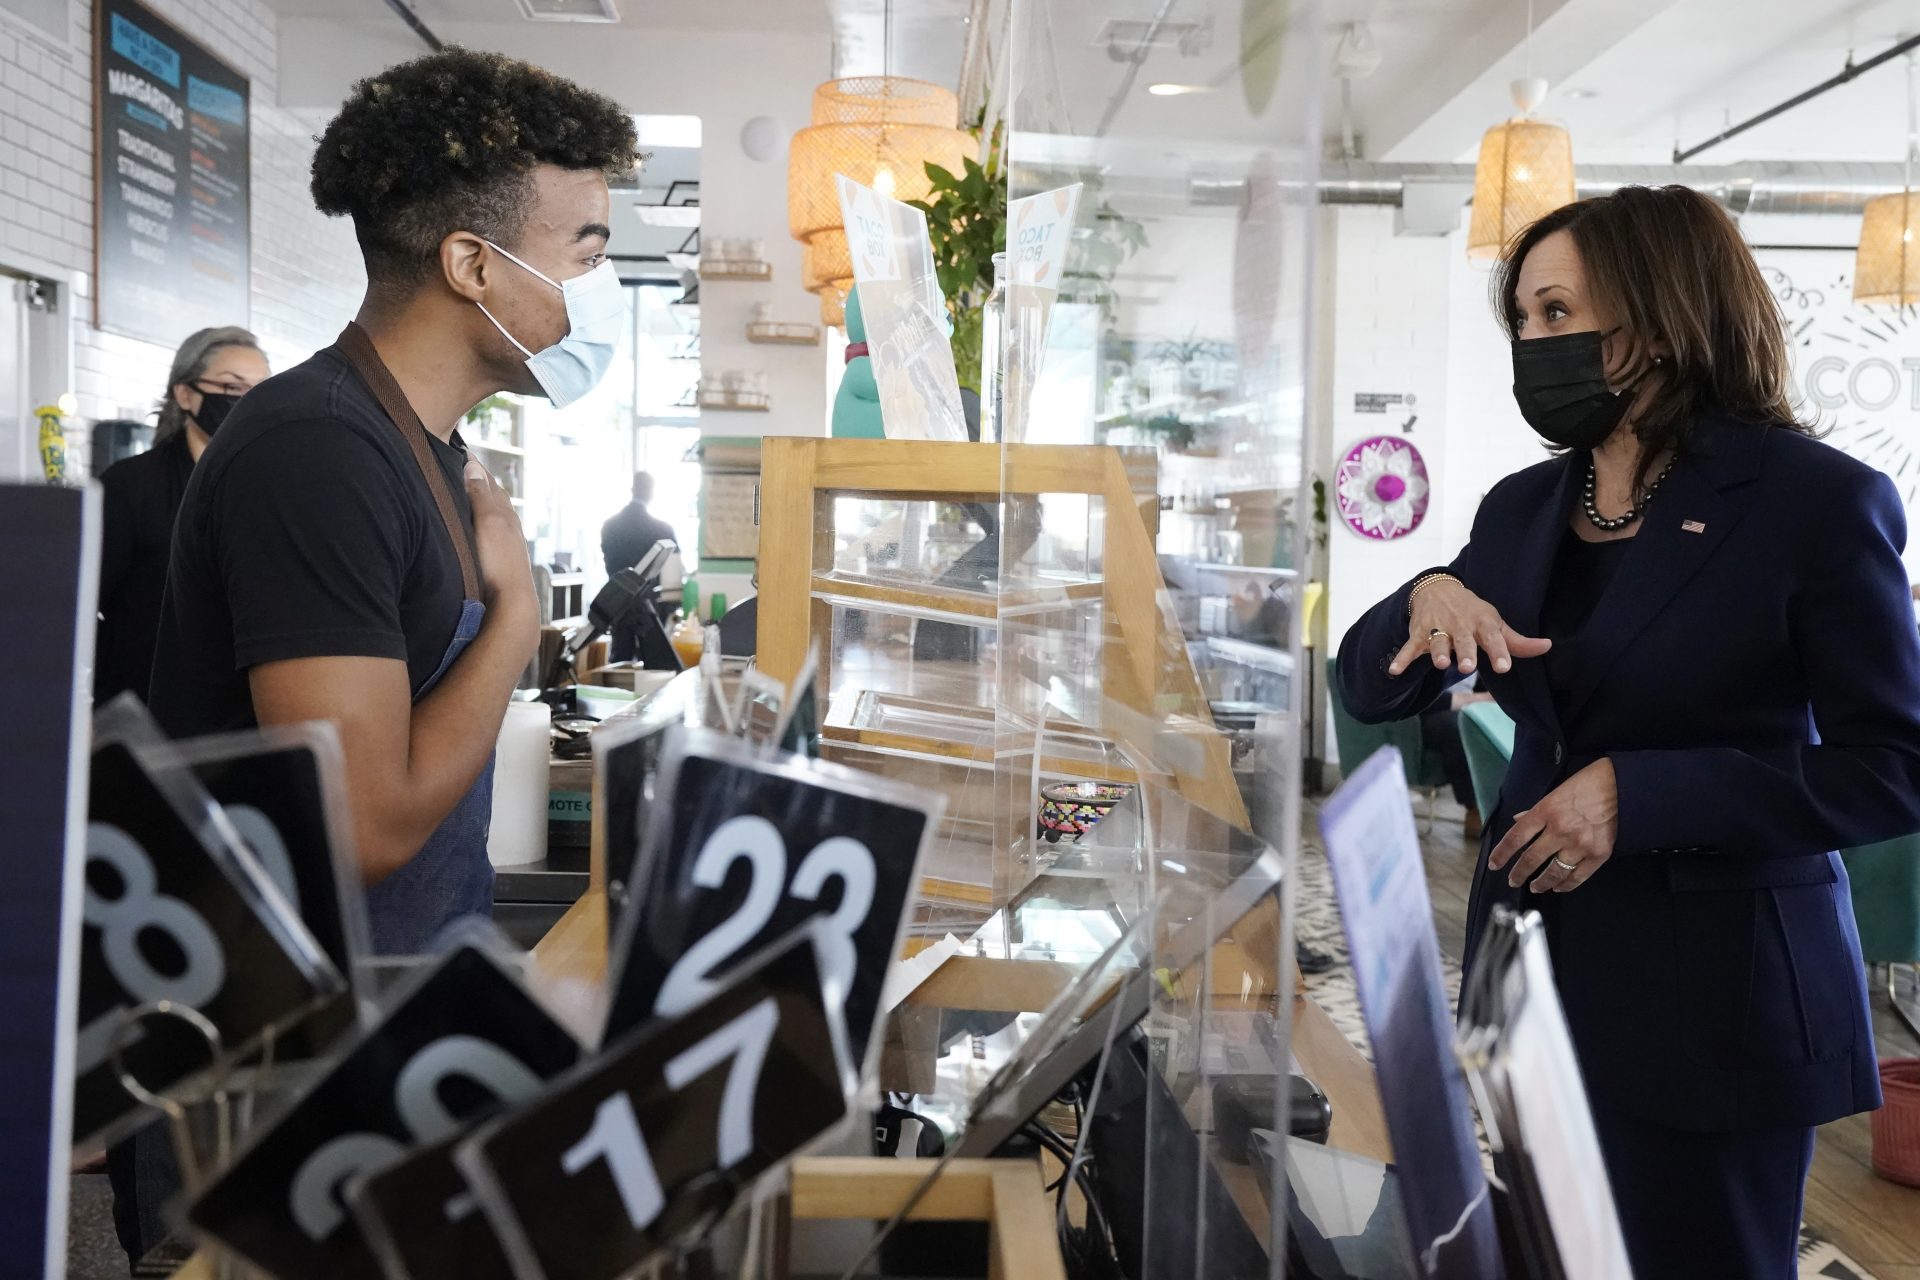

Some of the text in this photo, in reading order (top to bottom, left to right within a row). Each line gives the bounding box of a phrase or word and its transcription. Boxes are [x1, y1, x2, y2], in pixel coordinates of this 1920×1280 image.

[109, 69, 184, 131] MARGARITAS
[856, 214, 885, 240] TACO
[1799, 356, 1920, 412] COT
[80, 820, 226, 1040] 8
[652, 815, 877, 1019] 23
[560, 996, 780, 1231] 17
